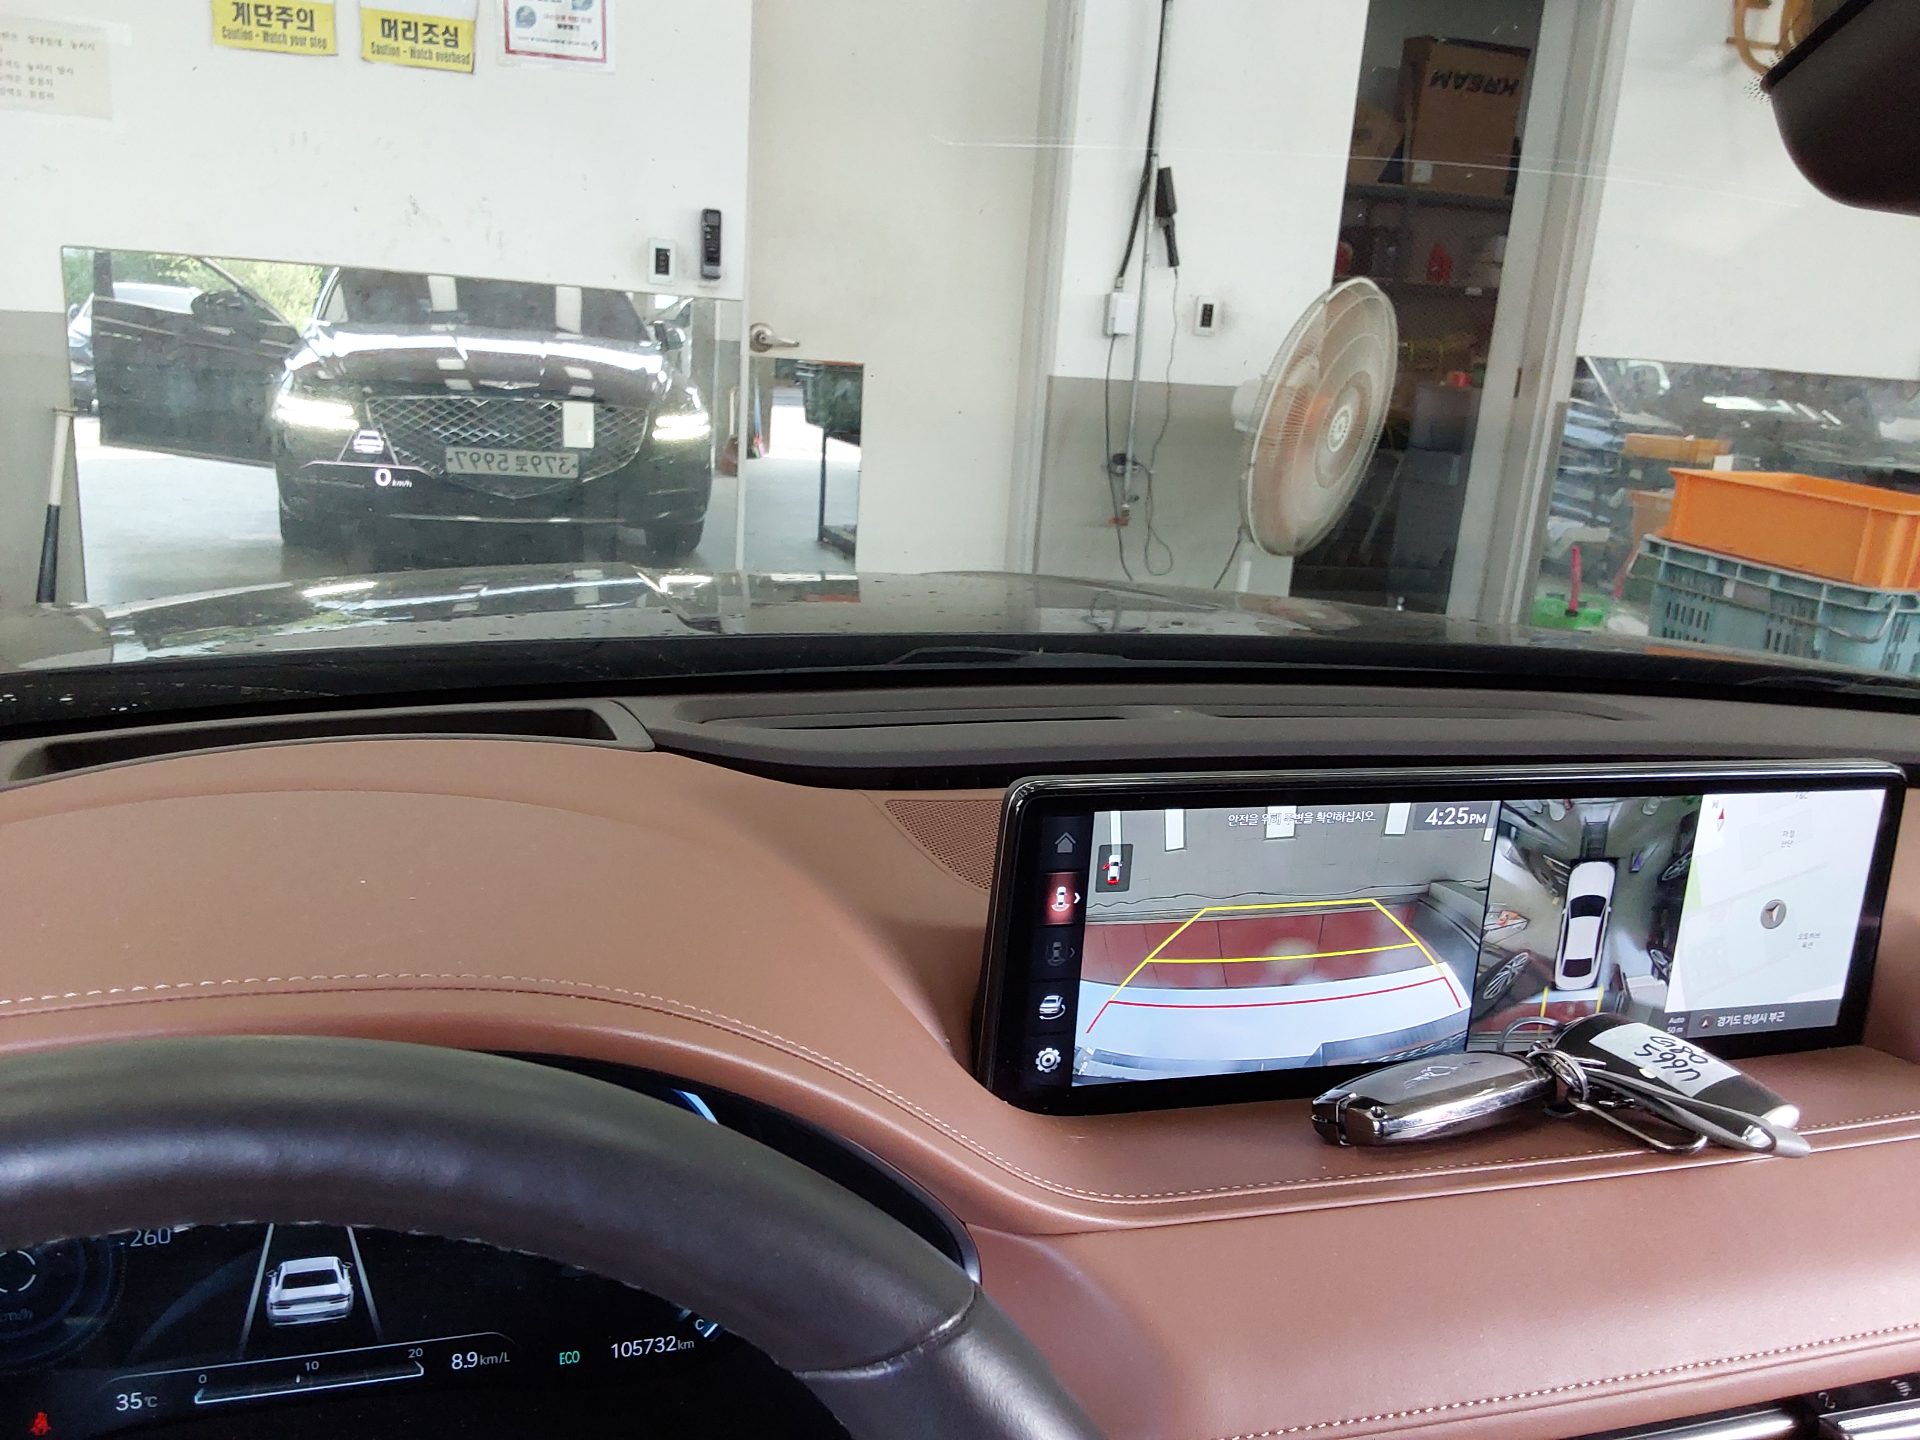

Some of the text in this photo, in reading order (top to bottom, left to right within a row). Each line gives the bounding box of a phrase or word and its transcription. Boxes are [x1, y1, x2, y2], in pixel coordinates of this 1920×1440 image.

[231, 1, 315, 32] 계단주의
[222, 26, 253, 41] Caution
[381, 18, 459, 49] 머리조심
[1429, 71, 1520, 97] KREAM
[1228, 809, 1376, 827] 안전을 위해 주변을 확인하십시오
[1717, 1011, 1785, 1027] 경기도 안성시 부근
[1634, 1043, 1702, 1082] 5997
[130, 1226, 171, 1247] 260
[695, 1319, 704, 1330] C
[408, 1348, 423, 1359] 20
[559, 1350, 581, 1365] ECO
[305, 1360, 319, 1371] 10
[198, 1374, 207, 1384] 0
